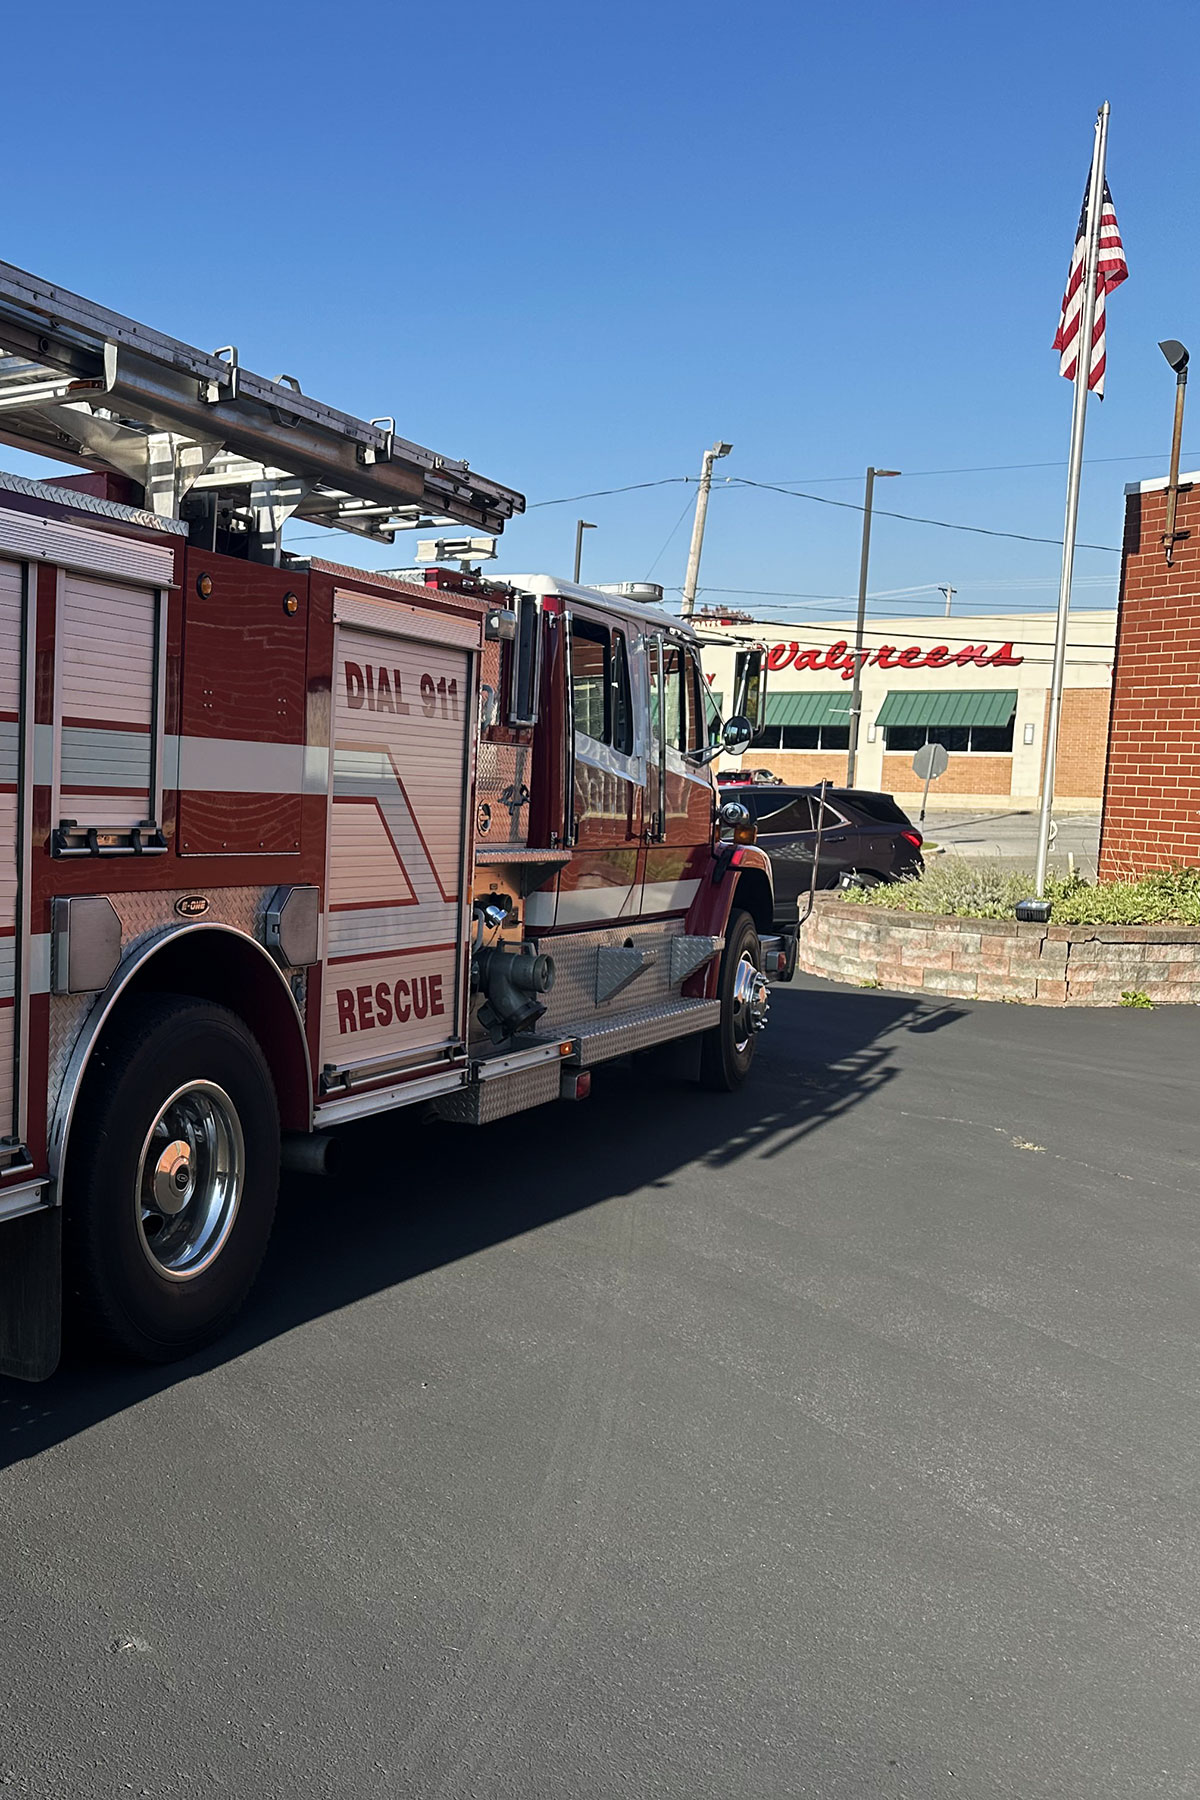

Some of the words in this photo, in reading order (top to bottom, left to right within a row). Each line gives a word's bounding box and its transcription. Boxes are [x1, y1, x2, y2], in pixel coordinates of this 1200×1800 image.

[757, 640, 1025, 681] Walgreens
[344, 661, 410, 715] DIAL
[420, 673, 460, 721] 911
[181, 900, 206, 911] E-ONE
[336, 974, 445, 1034] RESCUE
